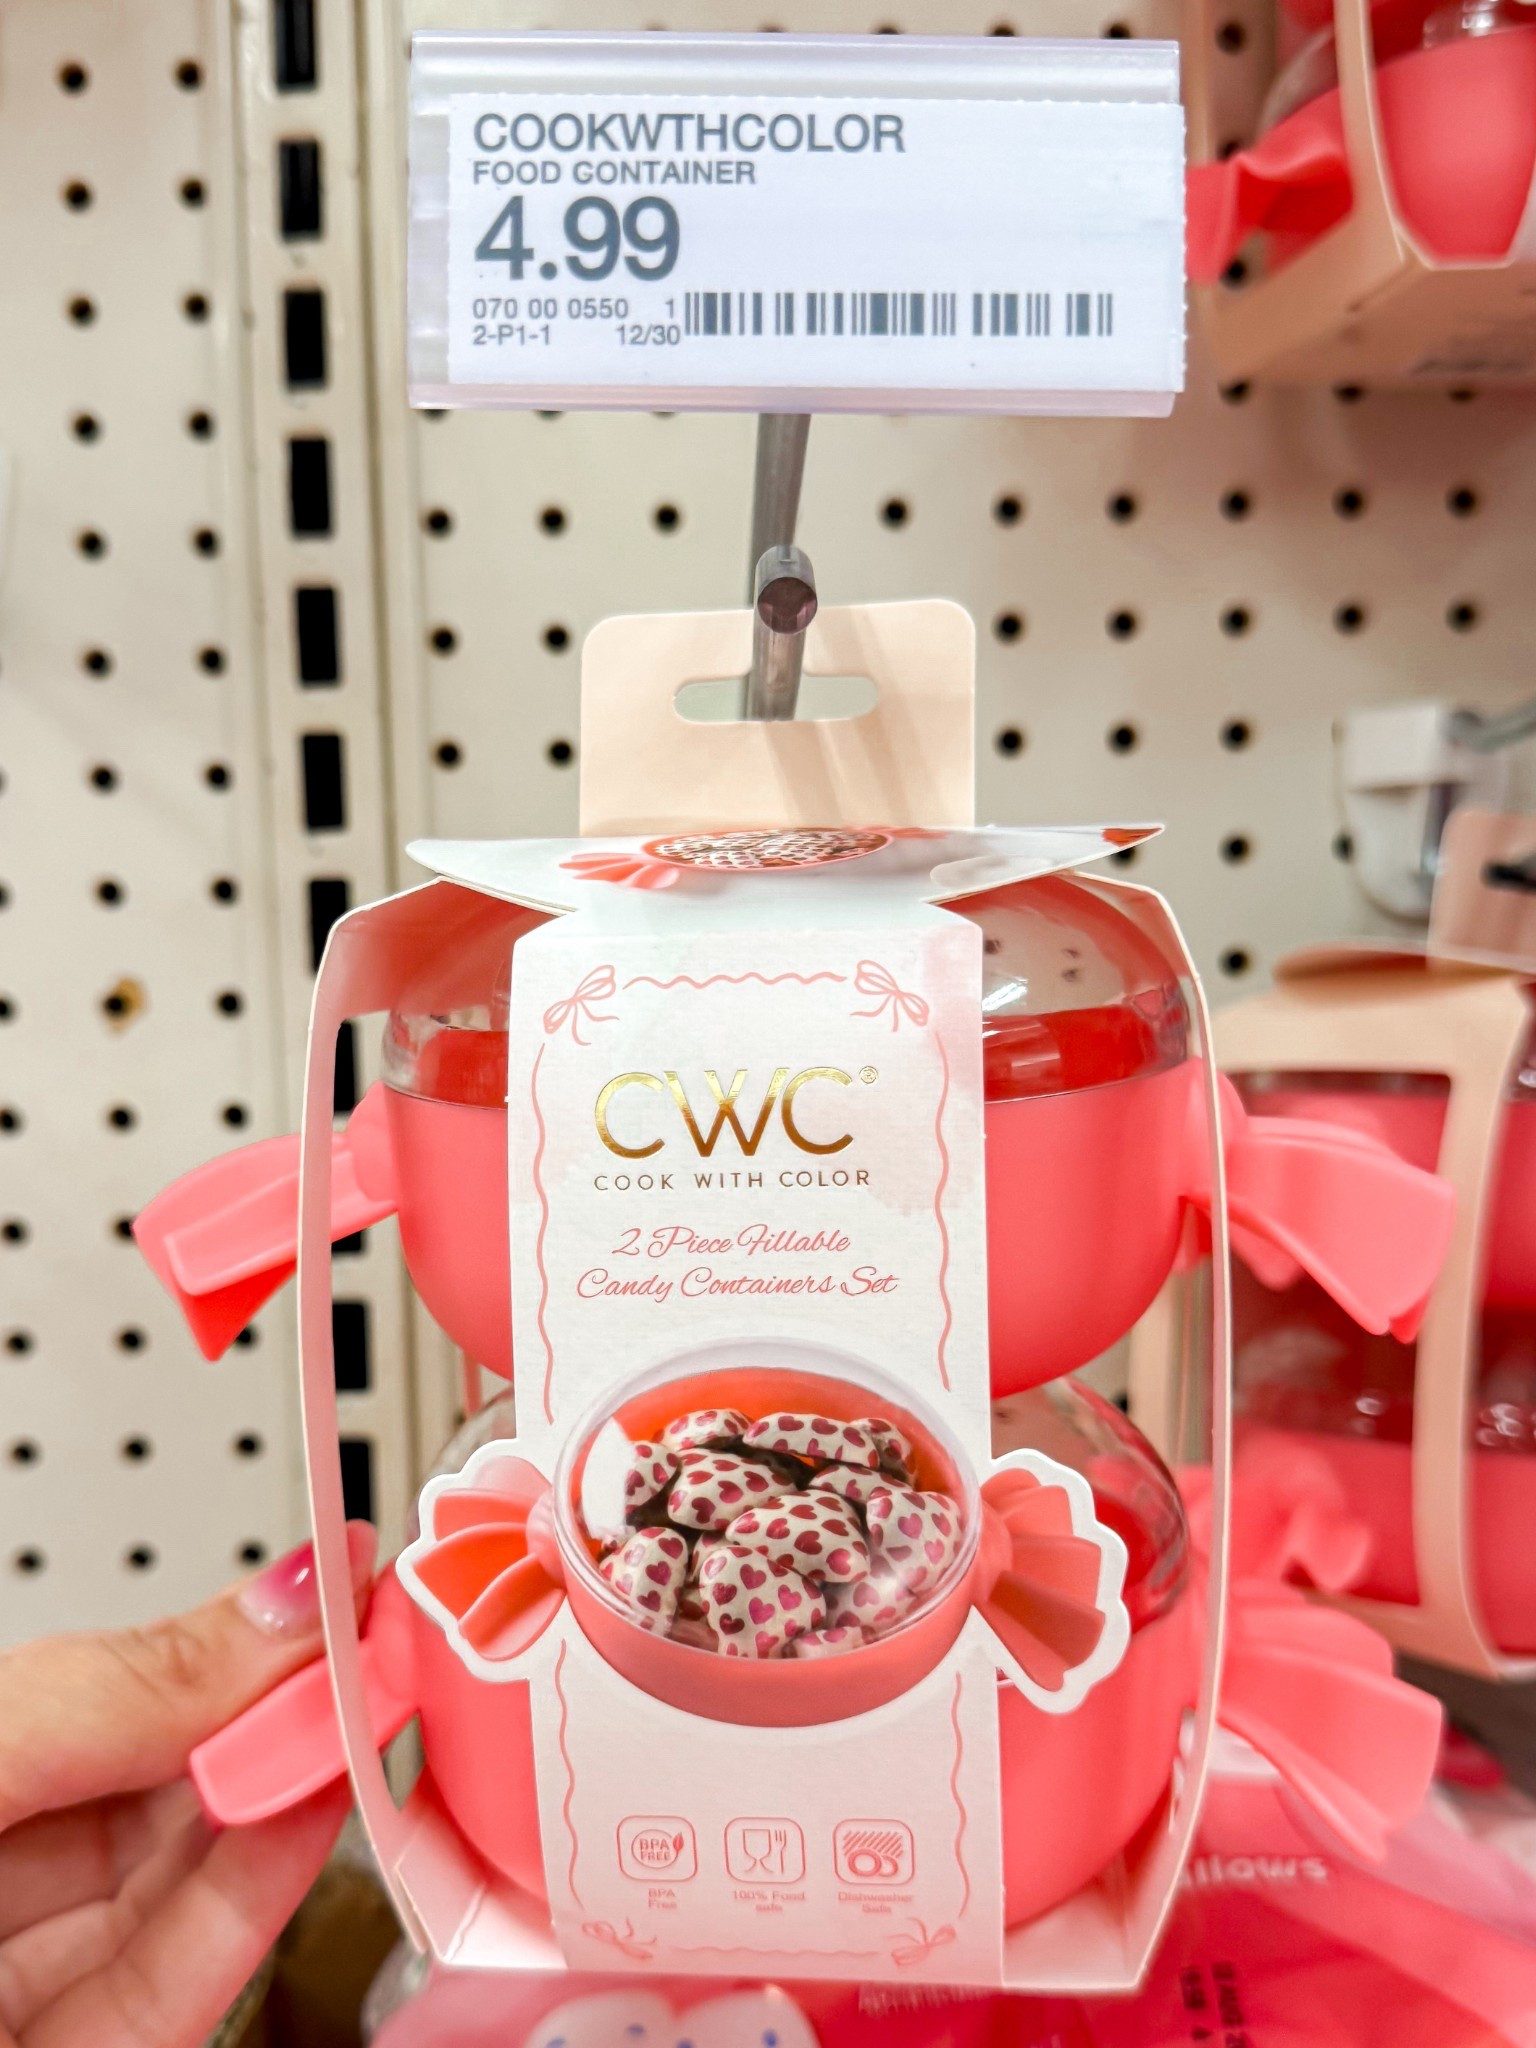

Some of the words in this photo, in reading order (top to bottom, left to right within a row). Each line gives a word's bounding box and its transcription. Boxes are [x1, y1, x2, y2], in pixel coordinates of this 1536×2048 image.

[473, 113, 906, 153] COOKWTHCOLOR
[473, 160, 561, 185] FOOD
[474, 195, 682, 281] 4.99
[472, 298, 518, 320] 070
[528, 298, 558, 320] 00
[567, 298, 629, 320] 0550
[664, 299, 676, 319] 1
[472, 324, 551, 346] 2-P1-1
[616, 324, 682, 346] 12/30
[594, 1172, 675, 1191] COOK
[694, 1171, 764, 1189] WITH
[778, 1169, 871, 1188] COLOR
[611, 1227, 641, 1256] 2
[646, 1225, 734, 1258] Piece
[736, 1223, 851, 1256] Fillable
[576, 1267, 674, 1303] Candy
[679, 1266, 836, 1298] Containers
[840, 1265, 901, 1297] Set
[639, 1837, 670, 1851] BPA
[640, 1850, 672, 1862] FREE
[648, 1887, 676, 1898] BPA
